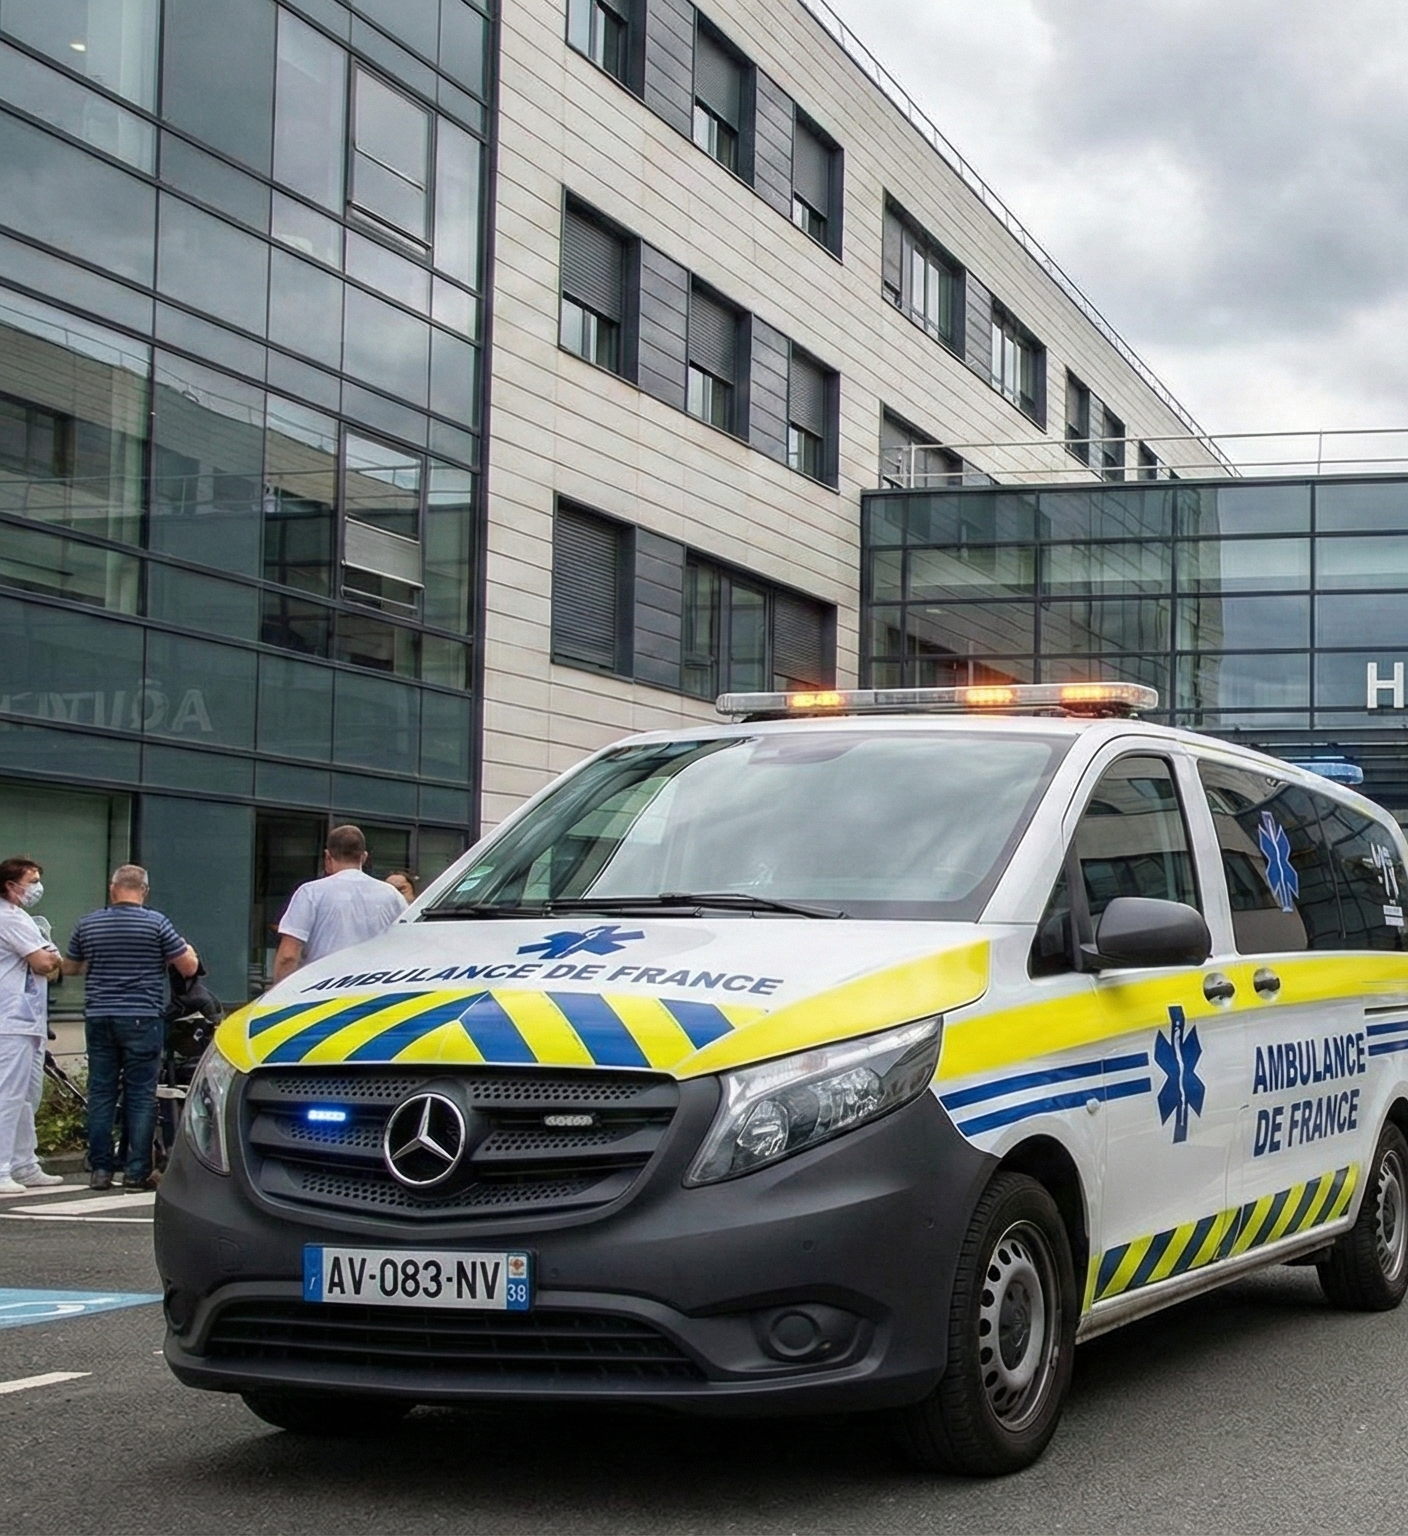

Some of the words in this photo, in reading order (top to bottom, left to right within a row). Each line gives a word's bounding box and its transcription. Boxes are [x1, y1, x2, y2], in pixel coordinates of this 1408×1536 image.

[300, 962, 541, 994] AMBULANCE
[544, 963, 597, 981] DE
[606, 965, 785, 996] FRANCE
[1252, 1032, 1366, 1095] AMBULANCE
[1253, 1106, 1285, 1157] DE
[1287, 1088, 1360, 1147] FRANCE
[327, 1255, 501, 1300] AV-083-NV
[506, 1283, 527, 1303] 38
